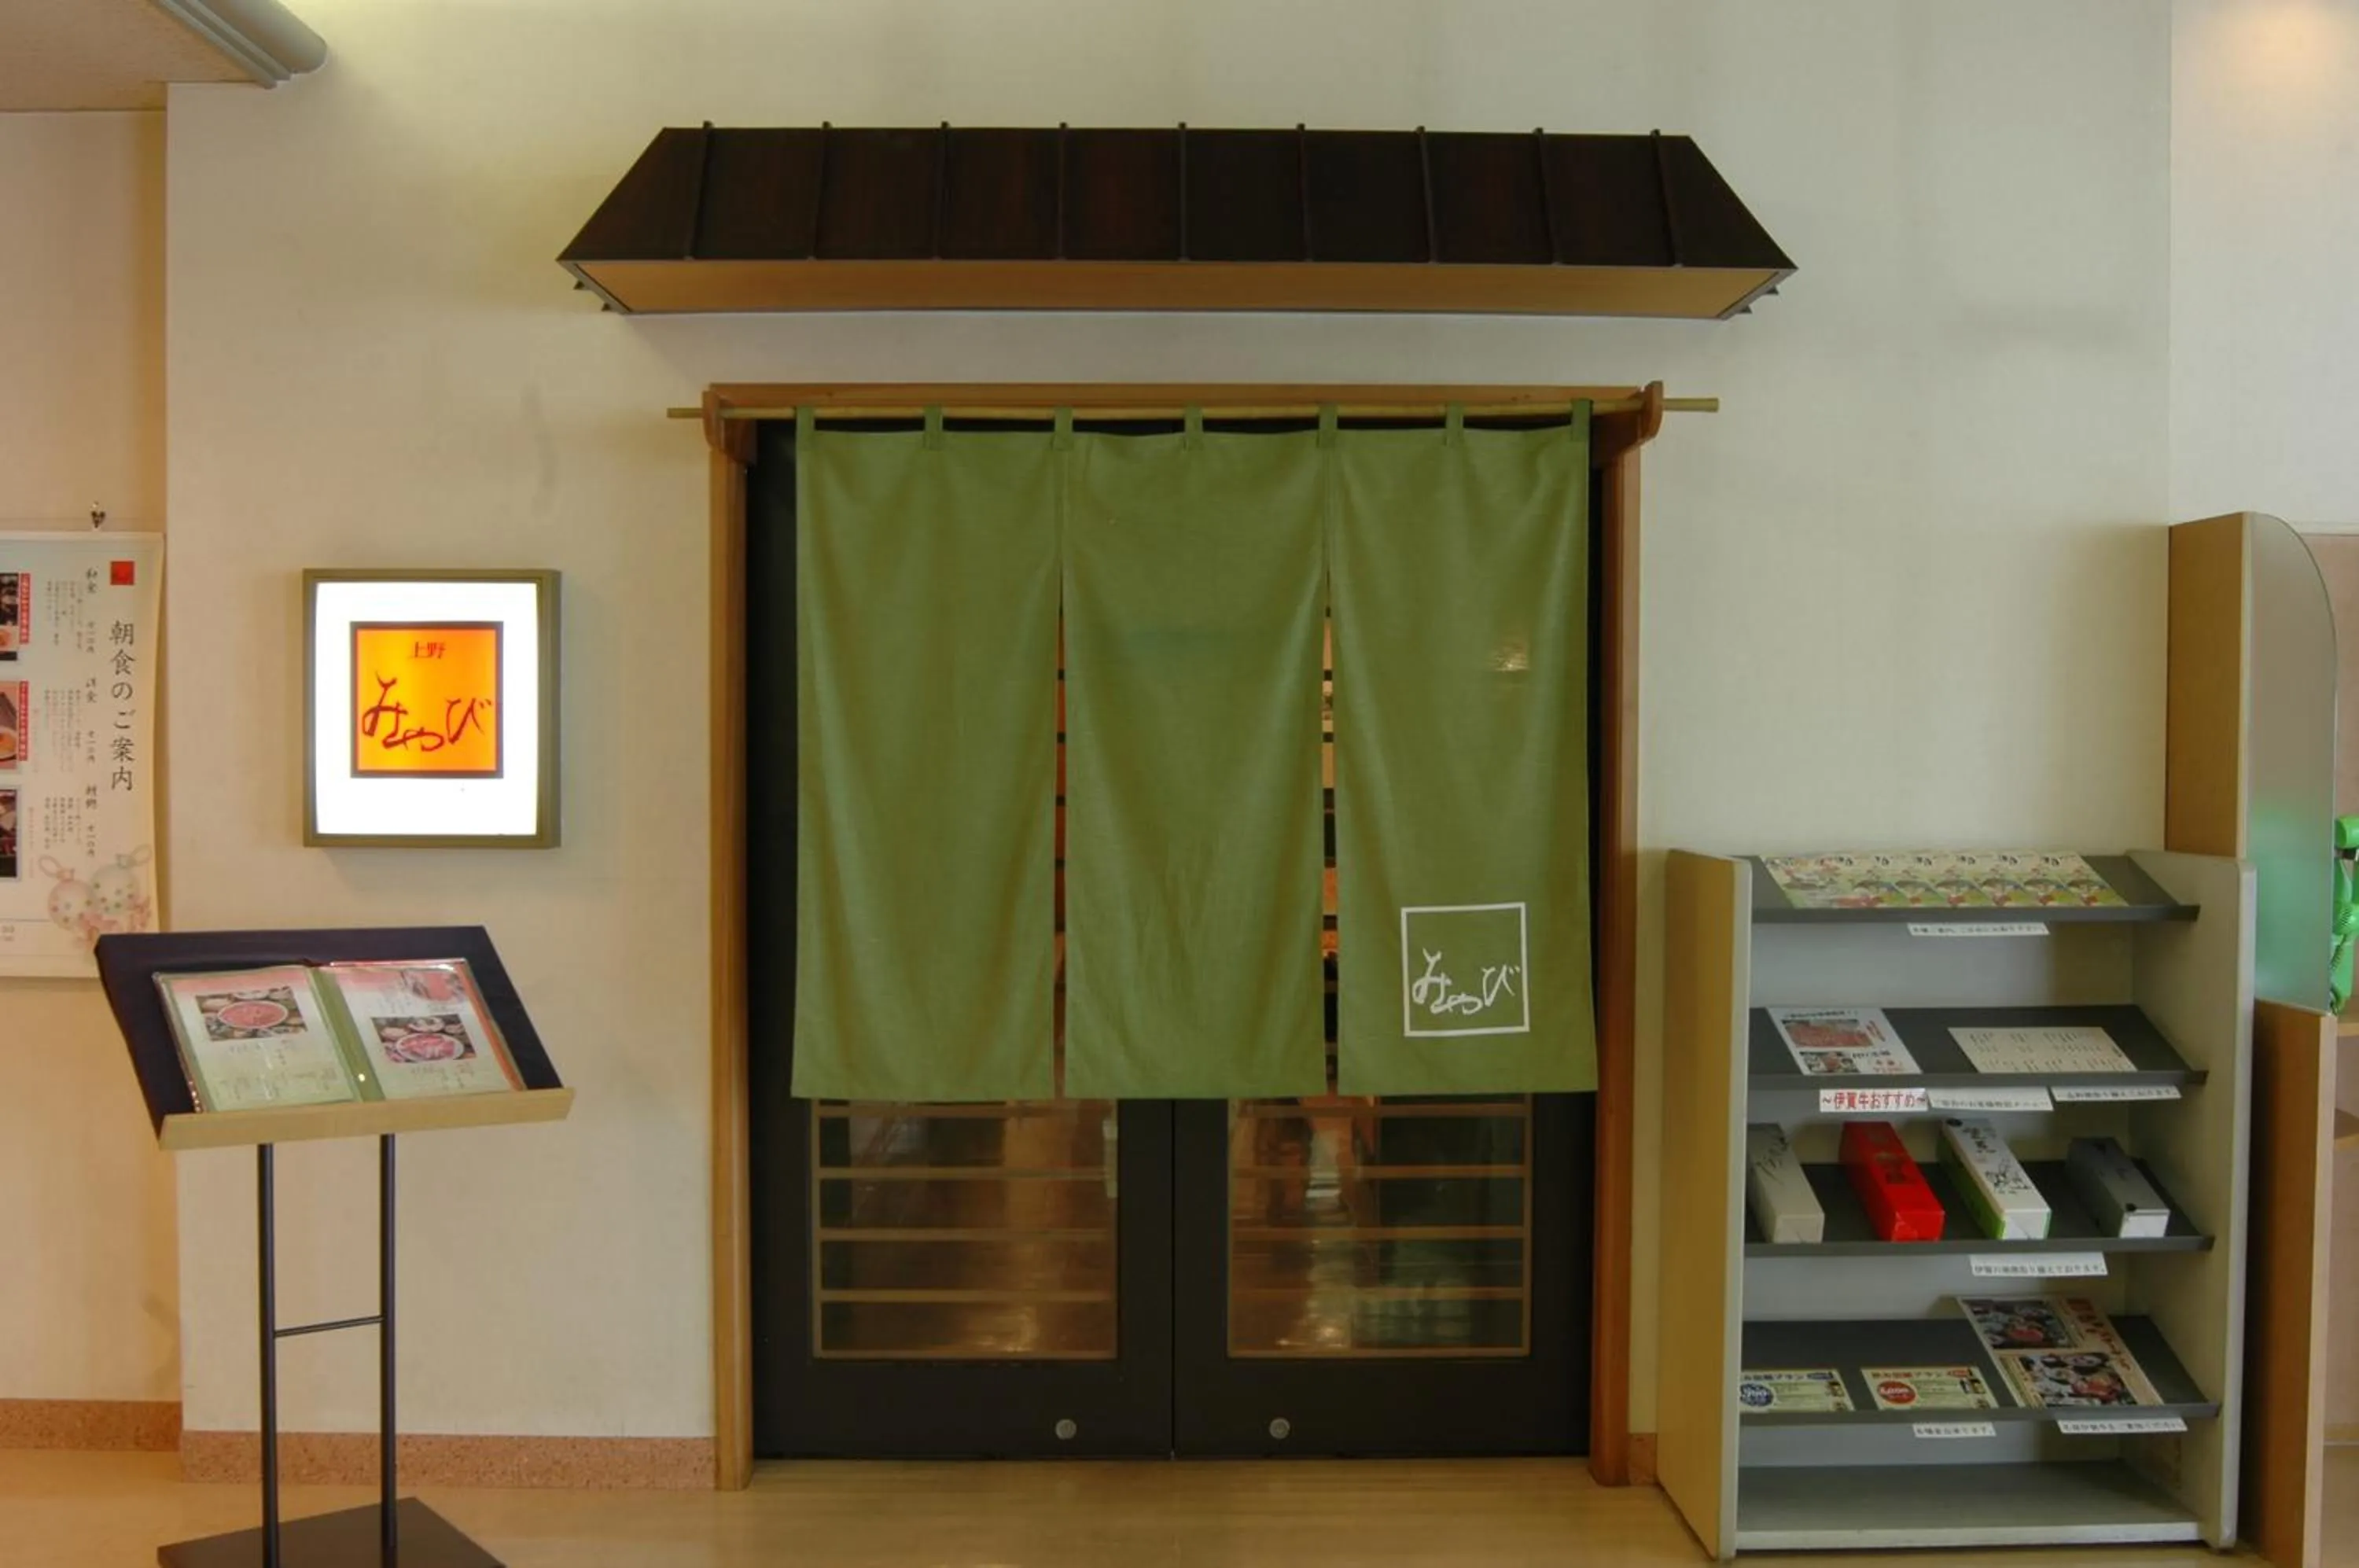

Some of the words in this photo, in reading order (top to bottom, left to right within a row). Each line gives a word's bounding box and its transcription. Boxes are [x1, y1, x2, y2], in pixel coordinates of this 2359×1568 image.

[408, 640, 447, 661] 上野
[109, 620, 136, 792] 朝食のご案内
